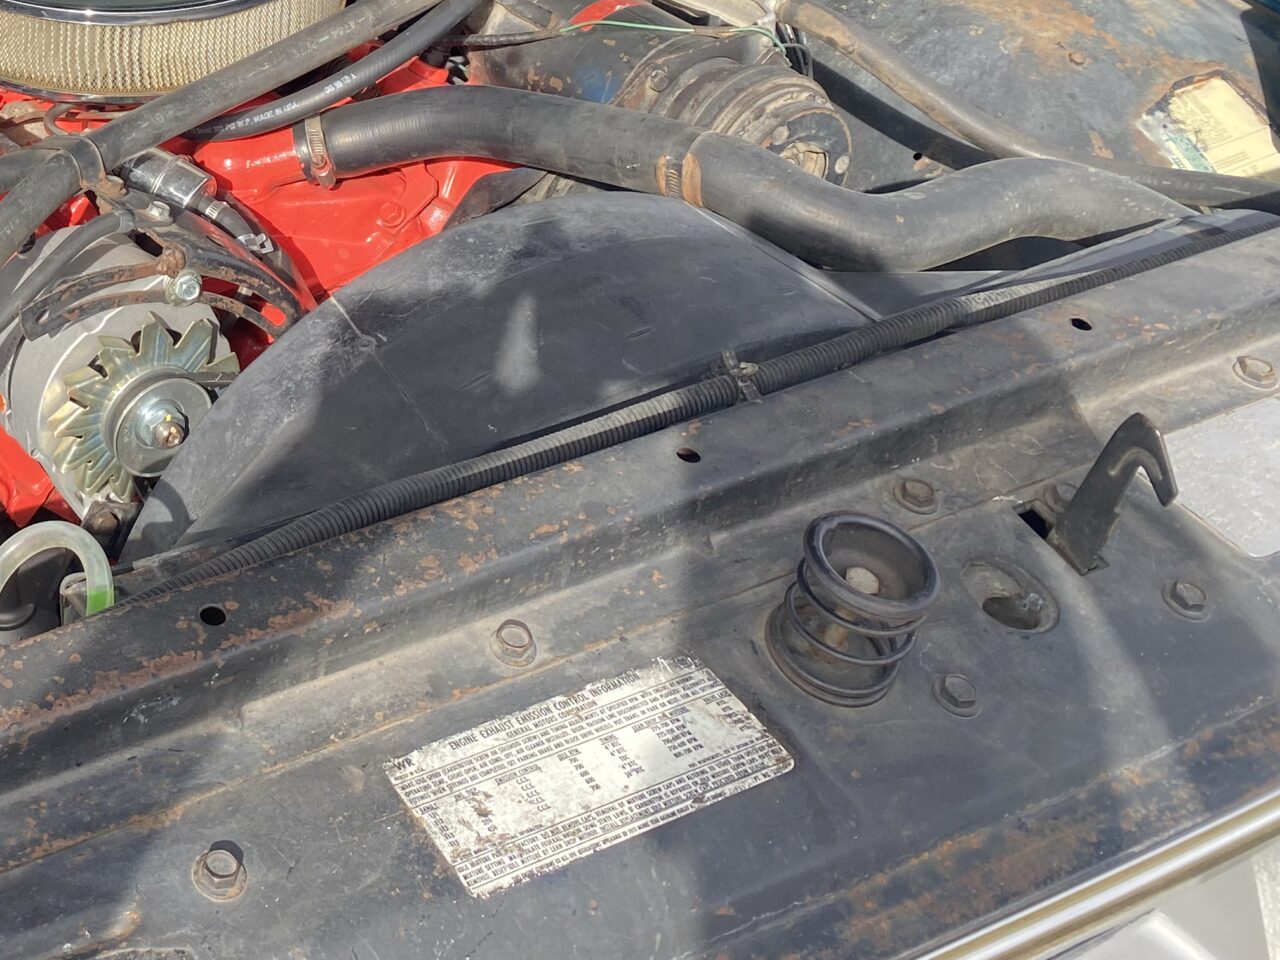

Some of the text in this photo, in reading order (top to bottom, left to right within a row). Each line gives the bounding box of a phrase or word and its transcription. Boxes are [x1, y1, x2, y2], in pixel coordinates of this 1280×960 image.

[393, 672, 641, 771] WR ENGINE EXHAUST EMISSION CONTROL INFORMATION
[505, 699, 598, 739] GENERAL MOTORS CORPORATION
